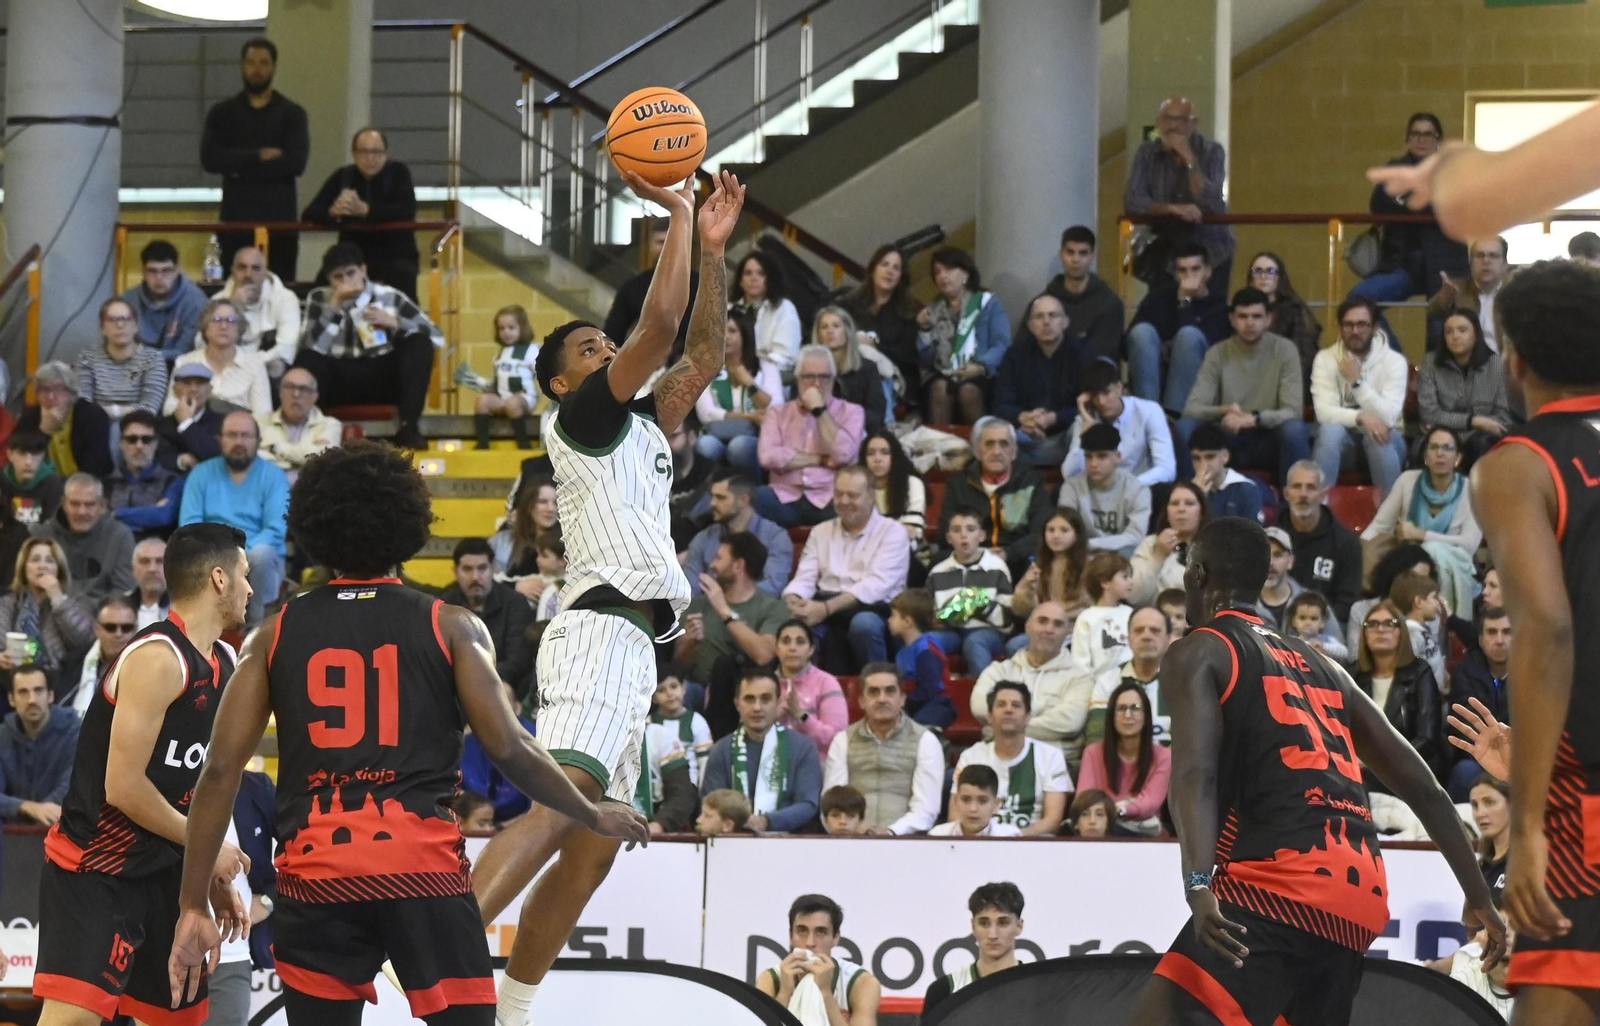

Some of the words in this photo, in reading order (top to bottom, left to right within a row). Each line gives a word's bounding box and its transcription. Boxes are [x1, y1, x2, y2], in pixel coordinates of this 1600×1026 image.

[632, 100, 696, 121] Wilson
[652, 134, 690, 152] EVO
[549, 626, 567, 638] PRO
[307, 643, 399, 749] 91
[1262, 675, 1363, 784] 55
[108, 932, 135, 972] 10
